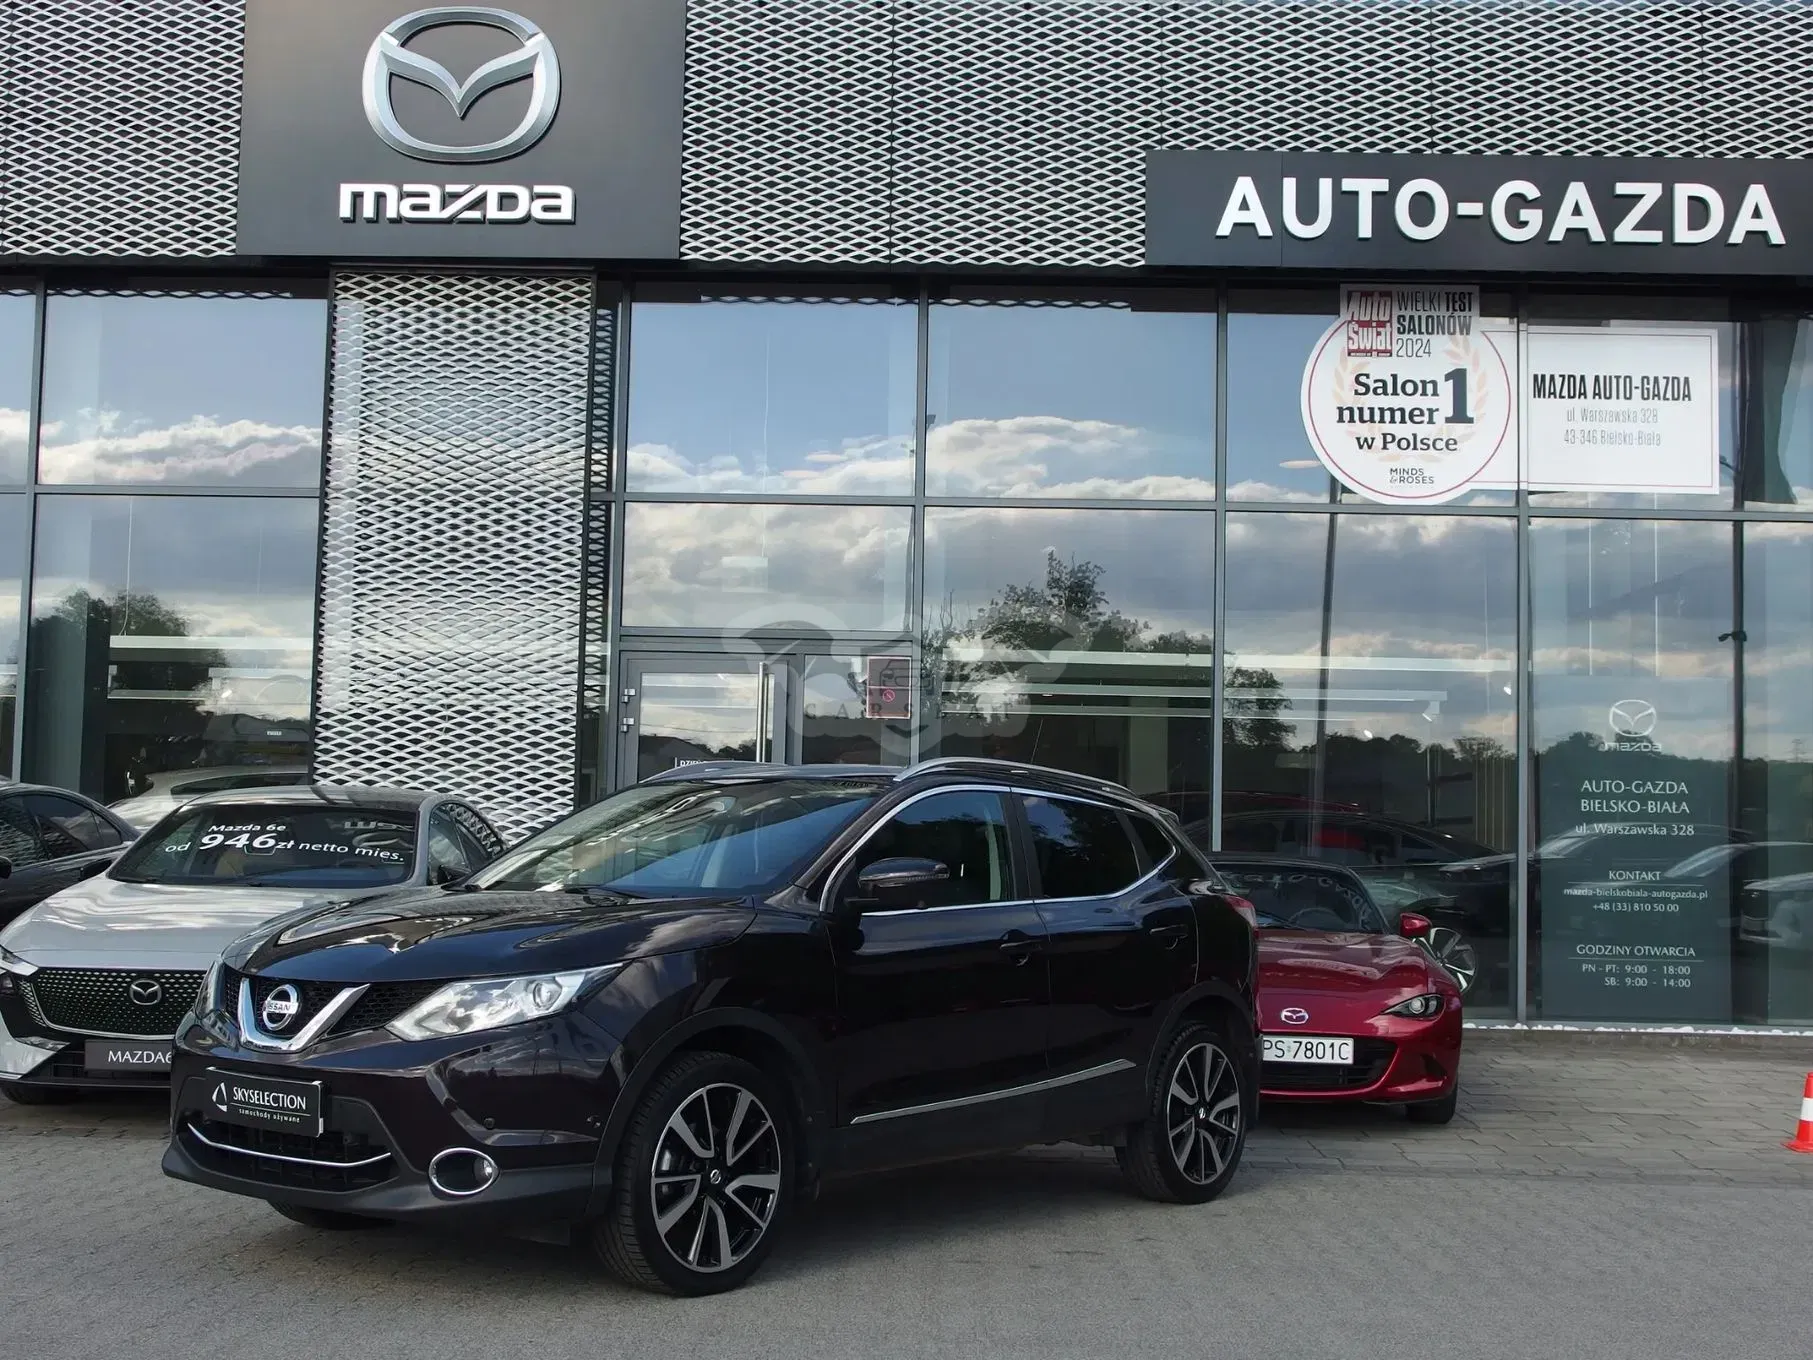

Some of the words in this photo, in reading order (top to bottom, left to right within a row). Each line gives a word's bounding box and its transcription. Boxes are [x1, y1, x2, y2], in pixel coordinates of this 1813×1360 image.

[1215, 176, 1787, 246] AUTO-GAZDA
[1347, 291, 1392, 321] Auto
[1396, 290, 1441, 312] WIELKI
[1445, 291, 1473, 312] TEST
[1396, 312, 1472, 336] SALONÓW
[1348, 321, 1392, 350] Świat
[1396, 338, 1431, 358] 2024
[1353, 373, 1440, 397] Salon
[1532, 374, 1588, 400] MAZDA
[1592, 375, 1692, 401] AUTO-GAZDA
[1444, 367, 1475, 424] 1
[1336, 406, 1440, 424] numer
[1566, 407, 1578, 423] ul.
[1580, 408, 1638, 423] Warszawska
[1640, 408, 1659, 424] 328
[1355, 436, 1376, 450] w
[1381, 433, 1458, 452] Polsce
[1564, 429, 1598, 445] 43-346
[1600, 429, 1661, 447] Bielsko-Biała
[1389, 467, 1425, 476] MINDS
[1580, 779, 1689, 795] AUTO-GAZDA
[1580, 799, 1691, 814] BIELSKO-BIAŁA
[207, 824, 261, 832] Mazda
[265, 823, 287, 832] 6e
[1575, 823, 1590, 834] ul.
[1594, 823, 1667, 836] Warszawska
[1671, 824, 1695, 836] 328
[164, 841, 192, 852] od
[298, 842, 349, 854] netto
[353, 847, 405, 862] mies.
[1608, 870, 1662, 881] KONTAKT
[1592, 902, 1610, 911] +48
[1612, 902, 1631, 913] (33)
[1633, 903, 1651, 912] 810
[1653, 903, 1665, 912] 50
[1666, 904, 1679, 912] 00
[1576, 944, 1632, 956] GODZINY
[1634, 945, 1696, 957] OTWARCIA
[1581, 963, 1597, 973] PN
[1605, 964, 1620, 974] PT:
[1624, 964, 1648, 974] 9:00
[1662, 965, 1691, 975] 18:00
[1604, 977, 1620, 986] SB:
[1624, 977, 1648, 987] 9:00
[1662, 978, 1691, 988] 14:00
[1292, 1041, 1350, 1061] 7801C
[232, 1086, 307, 1110] SKYSELECTION
[238, 1108, 271, 1120] samochody
[272, 1113, 301, 1124] używane
